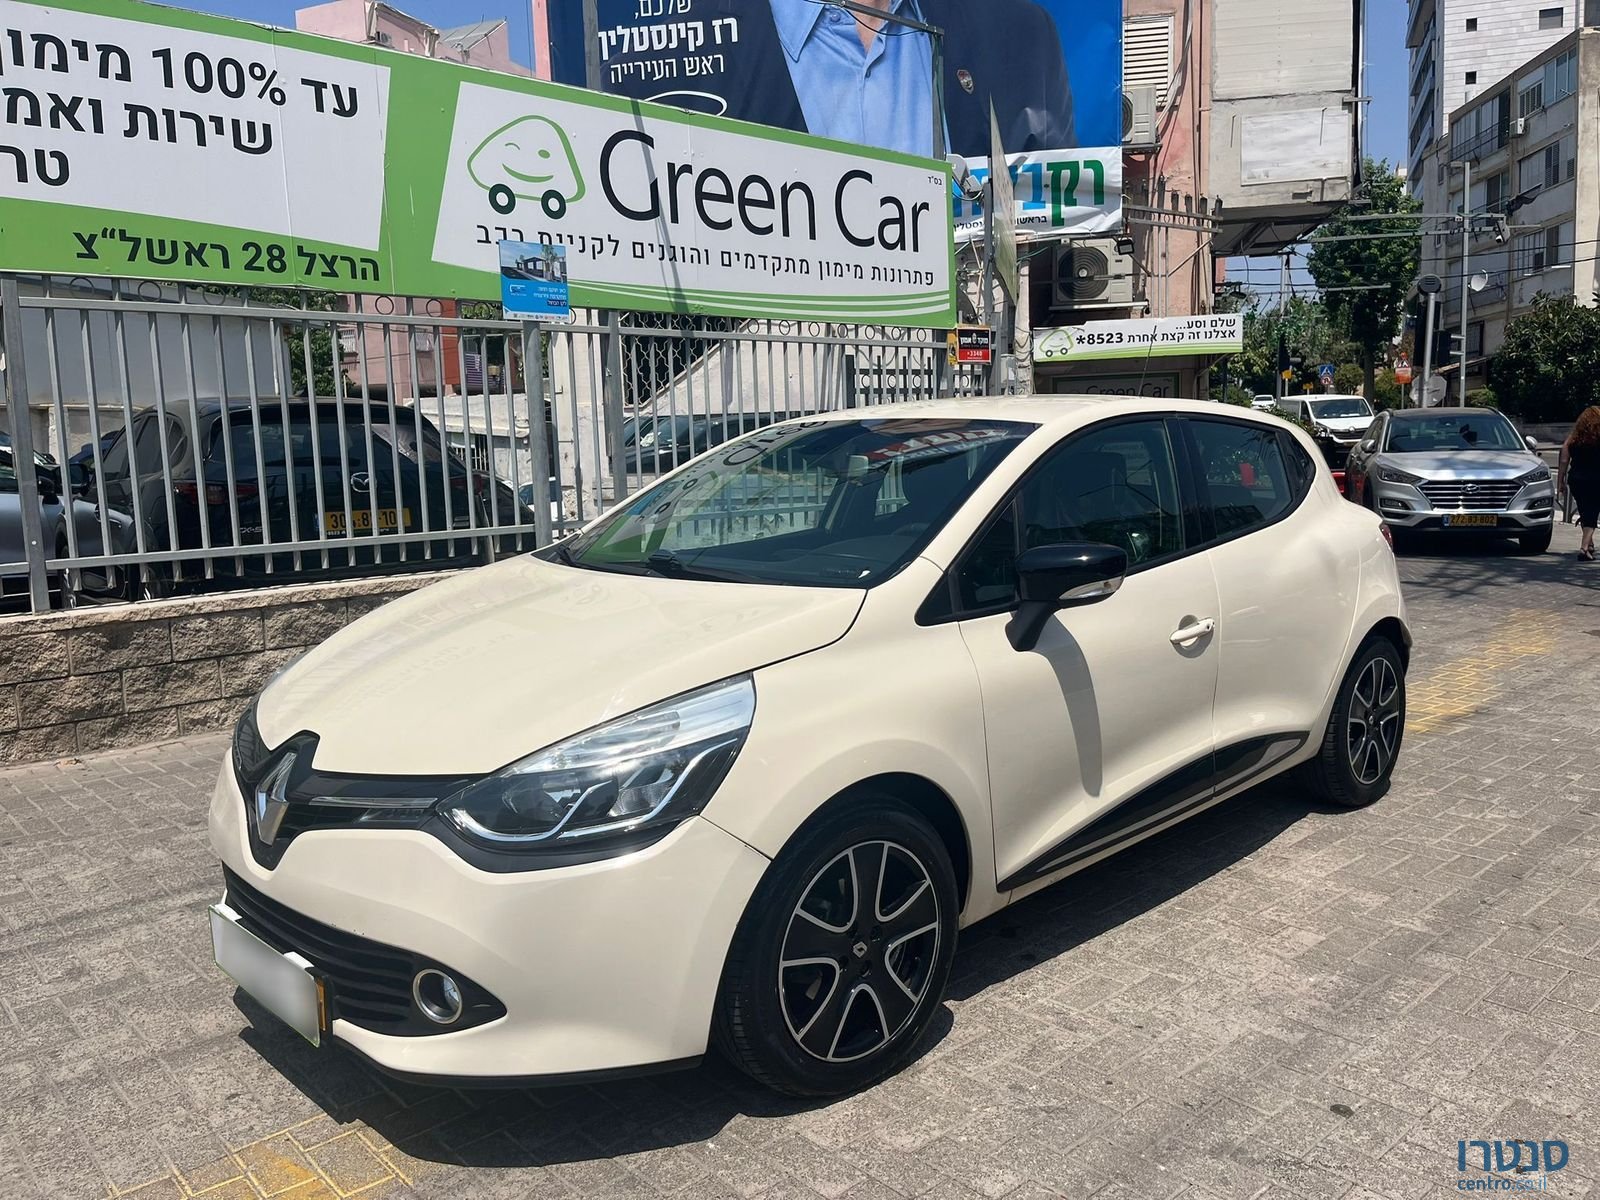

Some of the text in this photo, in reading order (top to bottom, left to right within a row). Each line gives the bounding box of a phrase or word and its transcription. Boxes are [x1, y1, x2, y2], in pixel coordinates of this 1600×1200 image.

[712, 17, 738, 44] רז
[0, 28, 358, 118] עד 100% מימו
[610, 54, 725, 84] ראש העירייה
[124, 103, 272, 155] שירות
[600, 129, 816, 239] Green
[834, 169, 930, 253] Car
[73, 227, 379, 281] הרצל 28 ראשל"צ
[632, 241, 709, 265] והוגנים
[721, 250, 810, 276] מתקדמים
[818, 260, 863, 281] מימון
[871, 265, 934, 286] פתרונות
[1204, 329, 1236, 340] אצלנו
[1210, 317, 1236, 328] שלם
[1127, 333, 1157, 343] אחרת
[1161, 332, 1184, 343] קצת
[1188, 331, 1201, 340] זה
